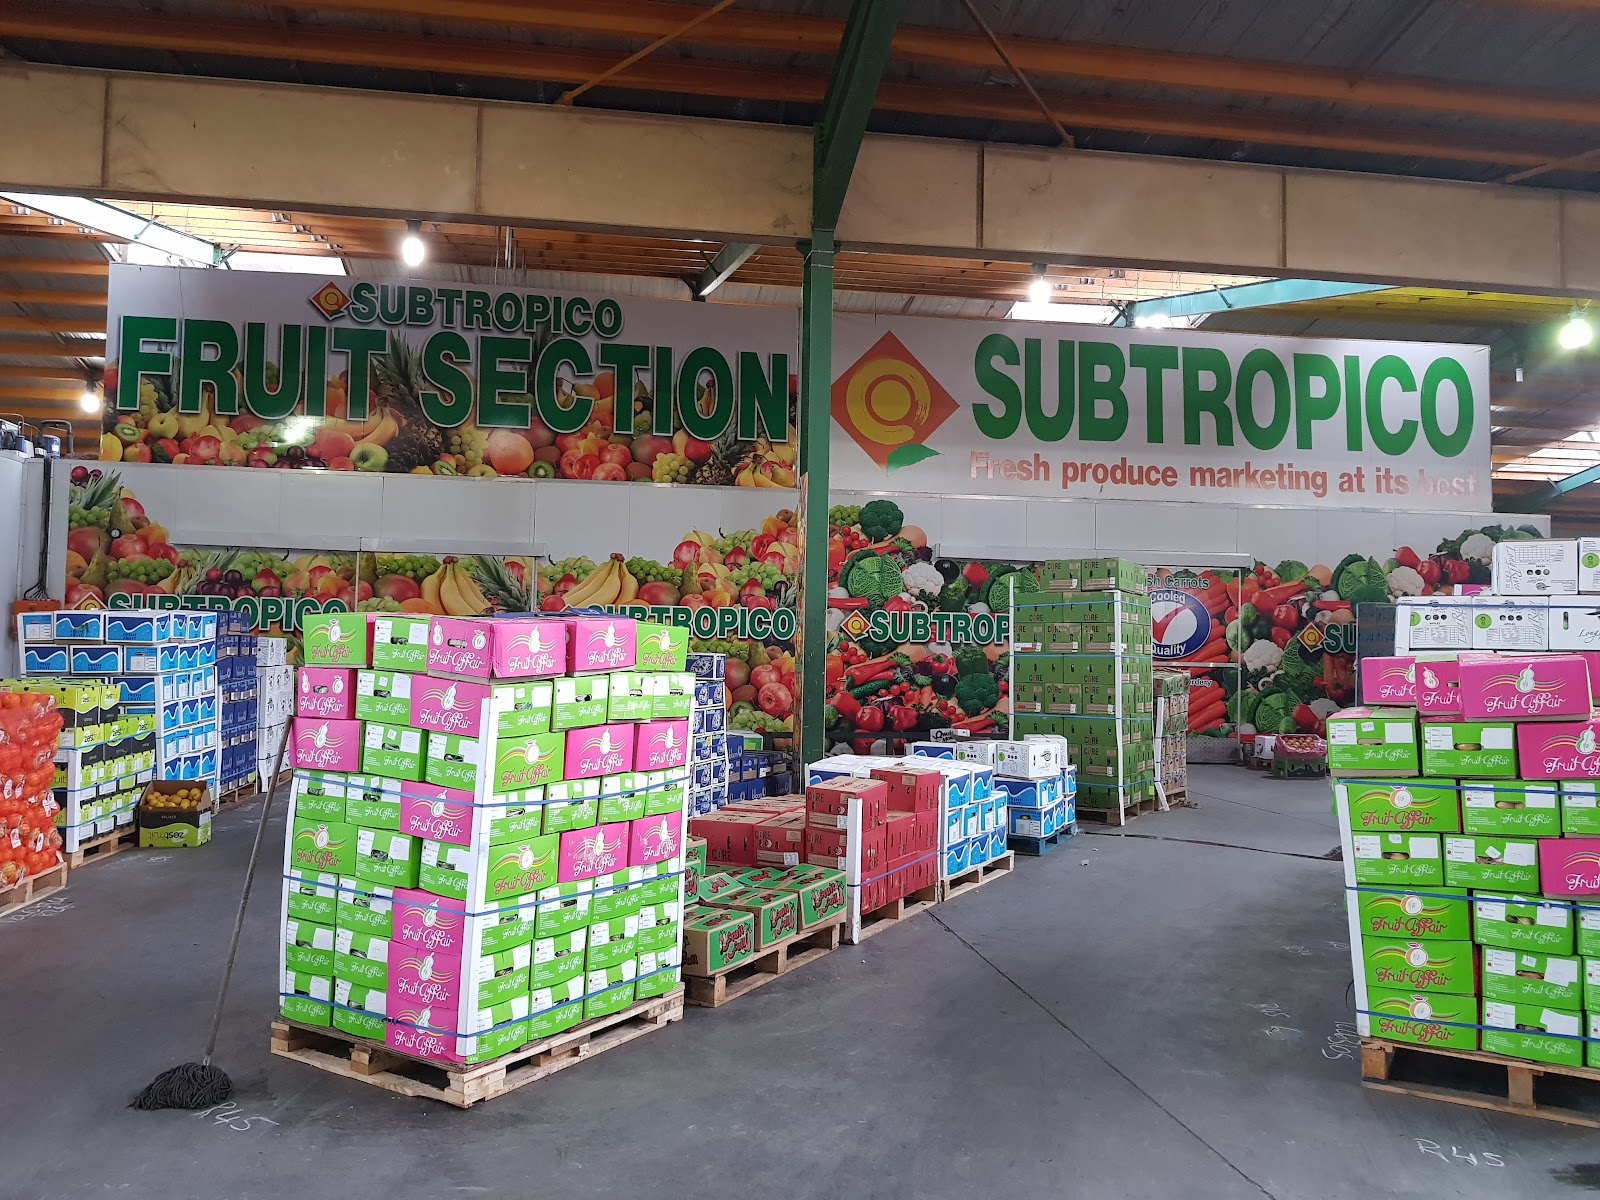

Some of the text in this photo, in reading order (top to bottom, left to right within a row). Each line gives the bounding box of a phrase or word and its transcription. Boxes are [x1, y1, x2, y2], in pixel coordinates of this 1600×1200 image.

[349, 282, 623, 336] SUBTROPICO
[116, 316, 789, 443] FRUIT SECTION
[971, 334, 1475, 458] SUBTROPICO
[970, 452, 1478, 497] Fresh produce marketing at its best
[1164, 577, 1209, 589] Carrots
[1150, 591, 1186, 604] Cooled
[312, 645, 327, 659] Fruit
[588, 647, 627, 666] Fruit Affair
[1151, 643, 1187, 655] Quality
[430, 649, 485, 671] Fruit Affair
[508, 654, 556, 673] Fruit Affair
[1380, 685, 1410, 698] Fruit
[1422, 691, 1456, 707] Fruit
[300, 697, 344, 715] Fruit Affair
[1484, 693, 1567, 713] Fruit Affair
[420, 709, 473, 731] Fruit Affair
[297, 749, 342, 768] Fruit Affair
[580, 754, 624, 773] Fruit Affair
[649, 752, 666, 766] Fruit
[1364, 749, 1386, 759] Fruit
[1386, 749, 1411, 761] Affair
[1460, 755, 1485, 766] Fruit
[1484, 755, 1510, 767] Affair
[1543, 757, 1581, 774] Fruit
[501, 764, 552, 786] Fruit Affair
[410, 816, 463, 839] Fruit Affair
[1360, 810, 1436, 830] Fruit Affair
[1502, 814, 1527, 825] Fruit
[1525, 814, 1552, 826] Affair
[297, 848, 315, 862] Fruit
[643, 847, 661, 860] Fruit
[573, 860, 598, 876] Fruit
[1387, 864, 1411, 875] Fruit
[1410, 864, 1436, 877] Affair
[1481, 868, 1532, 883] Fruit Affair
[494, 869, 547, 894] Fruit Affair
[1566, 873, 1600, 890] Fruit
[1371, 917, 1447, 937] Fruit Affair
[1511, 928, 1563, 944] Fruit Affair
[402, 924, 455, 950] Fruit Affair
[1376, 967, 1452, 989] Fruit Affair
[398, 978, 451, 1003] Fruit Affair
[1521, 983, 1574, 1000] Fruit Affair
[1379, 1018, 1455, 1042] Fruit Affair
[395, 1030, 447, 1056] Fruit Affair
[1521, 1037, 1574, 1054] Fruit Affair
